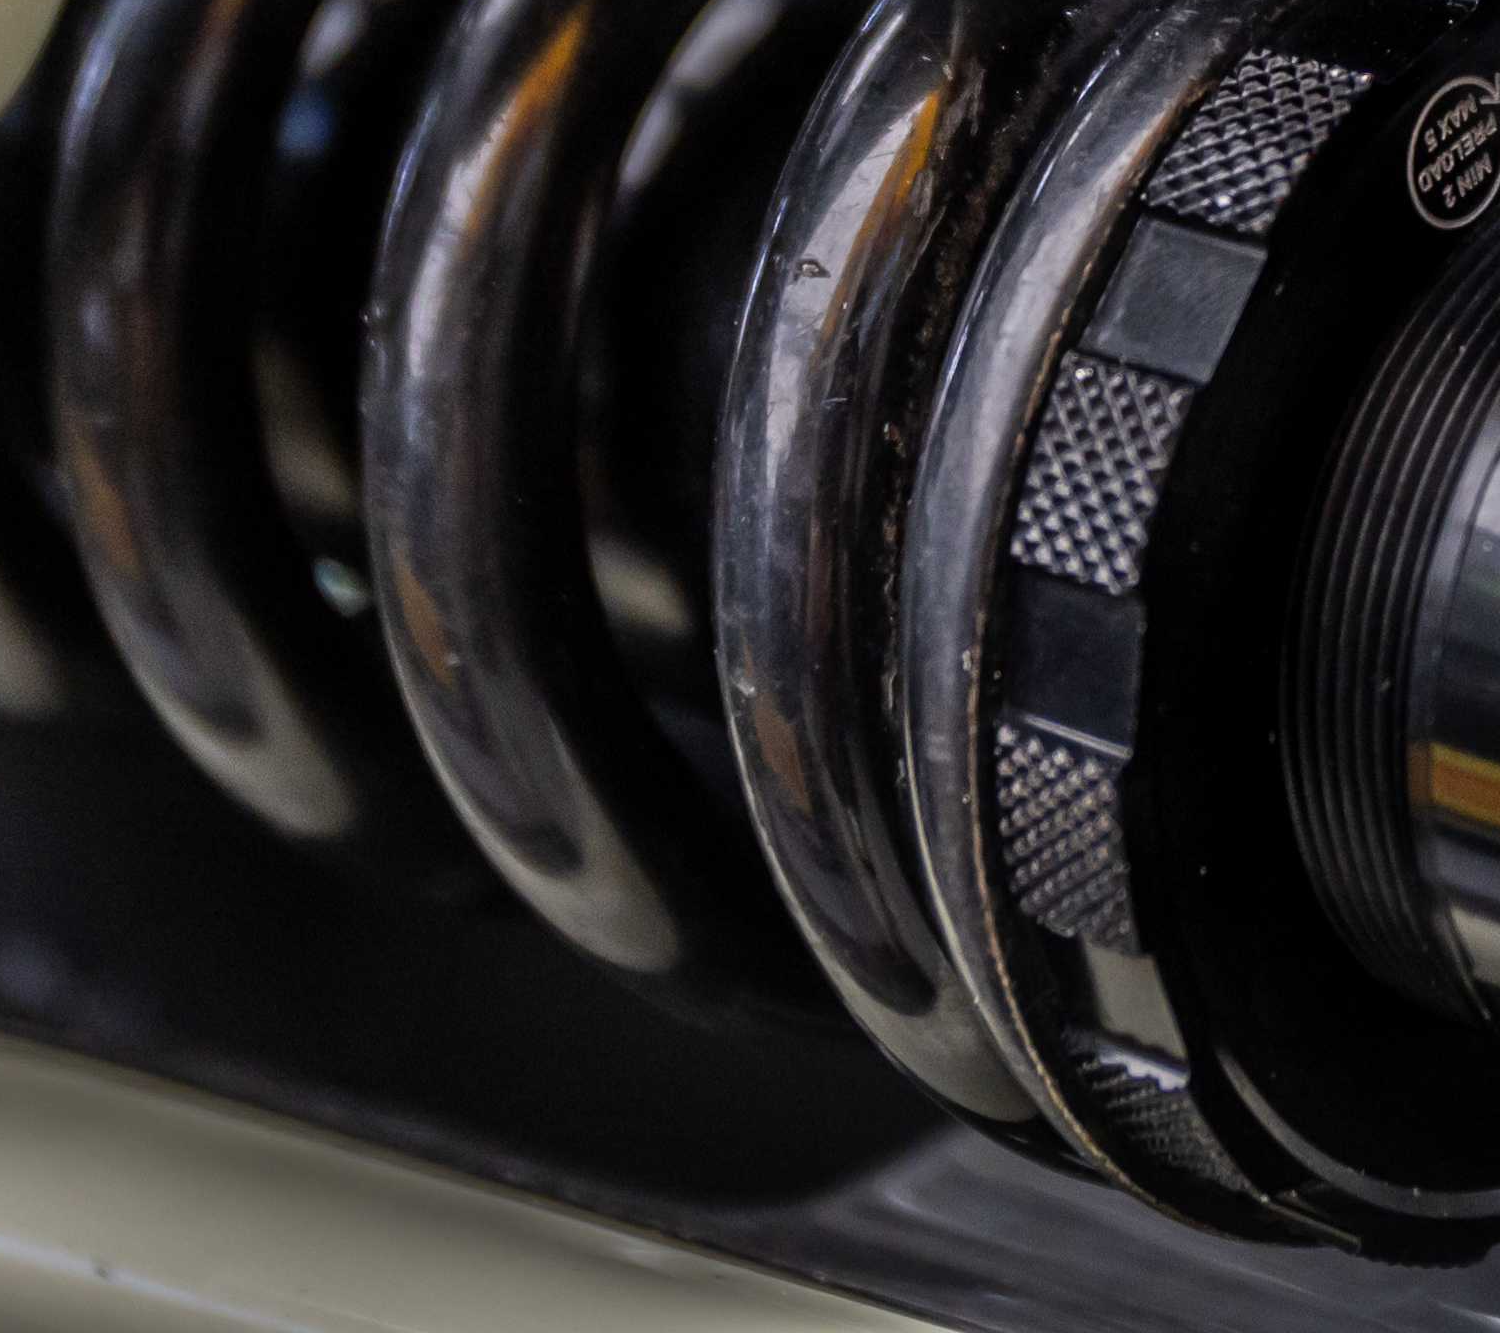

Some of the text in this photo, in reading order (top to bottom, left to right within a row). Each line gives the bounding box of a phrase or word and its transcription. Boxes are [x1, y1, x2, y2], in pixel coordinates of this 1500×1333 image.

[1436, 93, 1478, 142] MAX
[1417, 110, 1498, 194] PRELOAD
[1441, 151, 1493, 209] MIN 2
